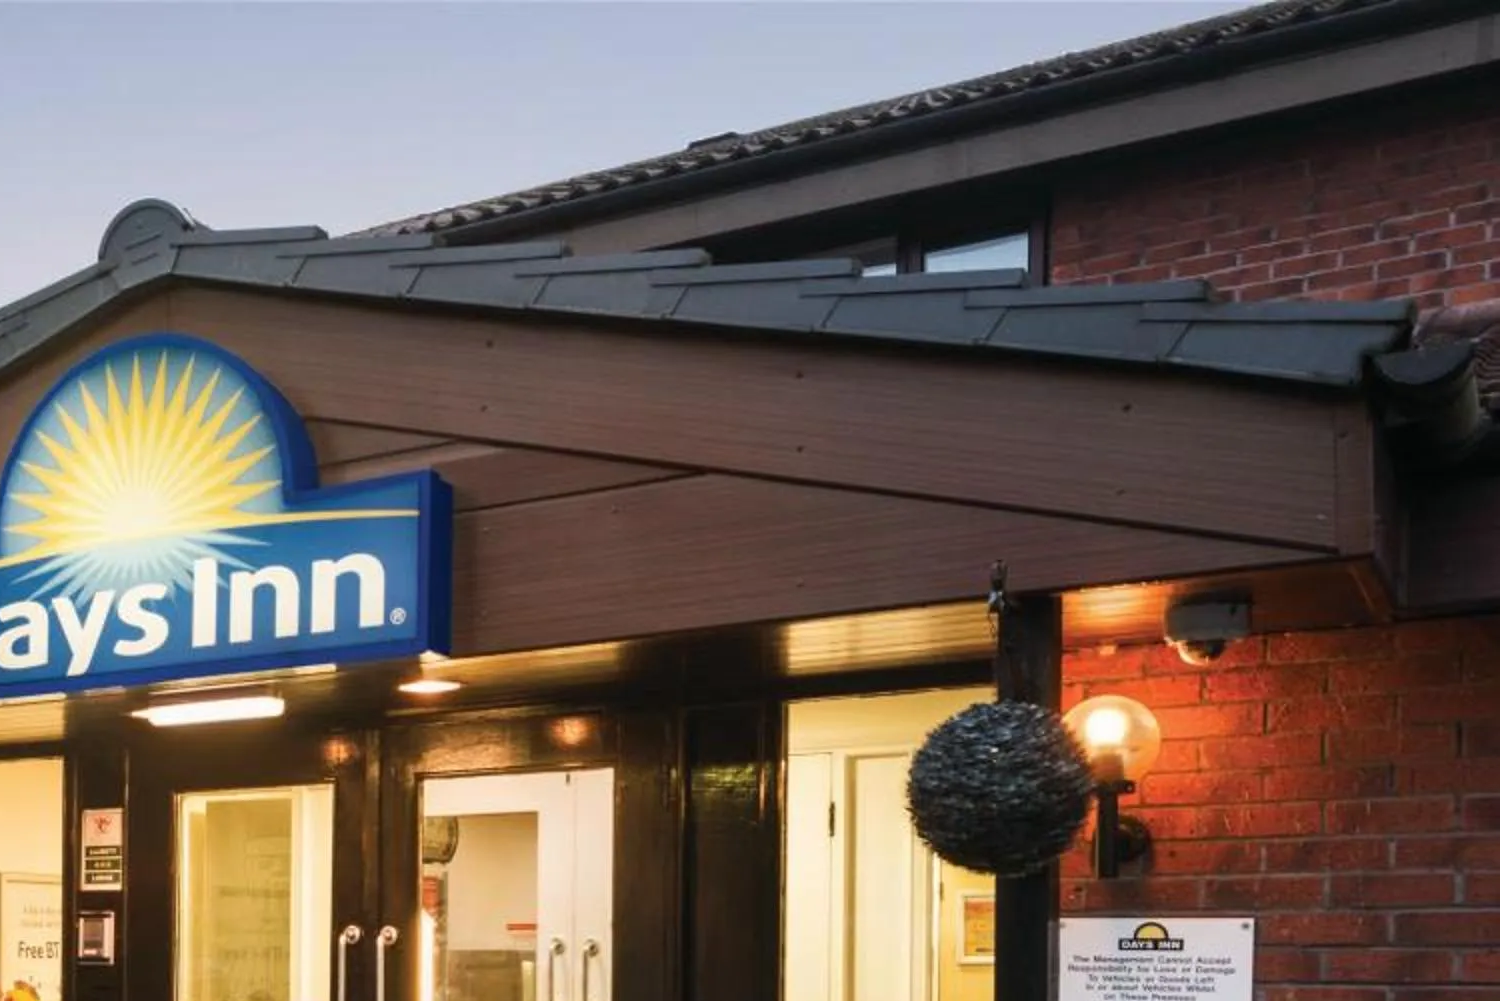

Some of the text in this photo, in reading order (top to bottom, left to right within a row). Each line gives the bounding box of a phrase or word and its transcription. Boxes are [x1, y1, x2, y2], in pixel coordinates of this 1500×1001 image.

[192, 552, 386, 648] Inn
[18, 941, 43, 959] Free
[1121, 941, 1181, 949] DAYS INN
